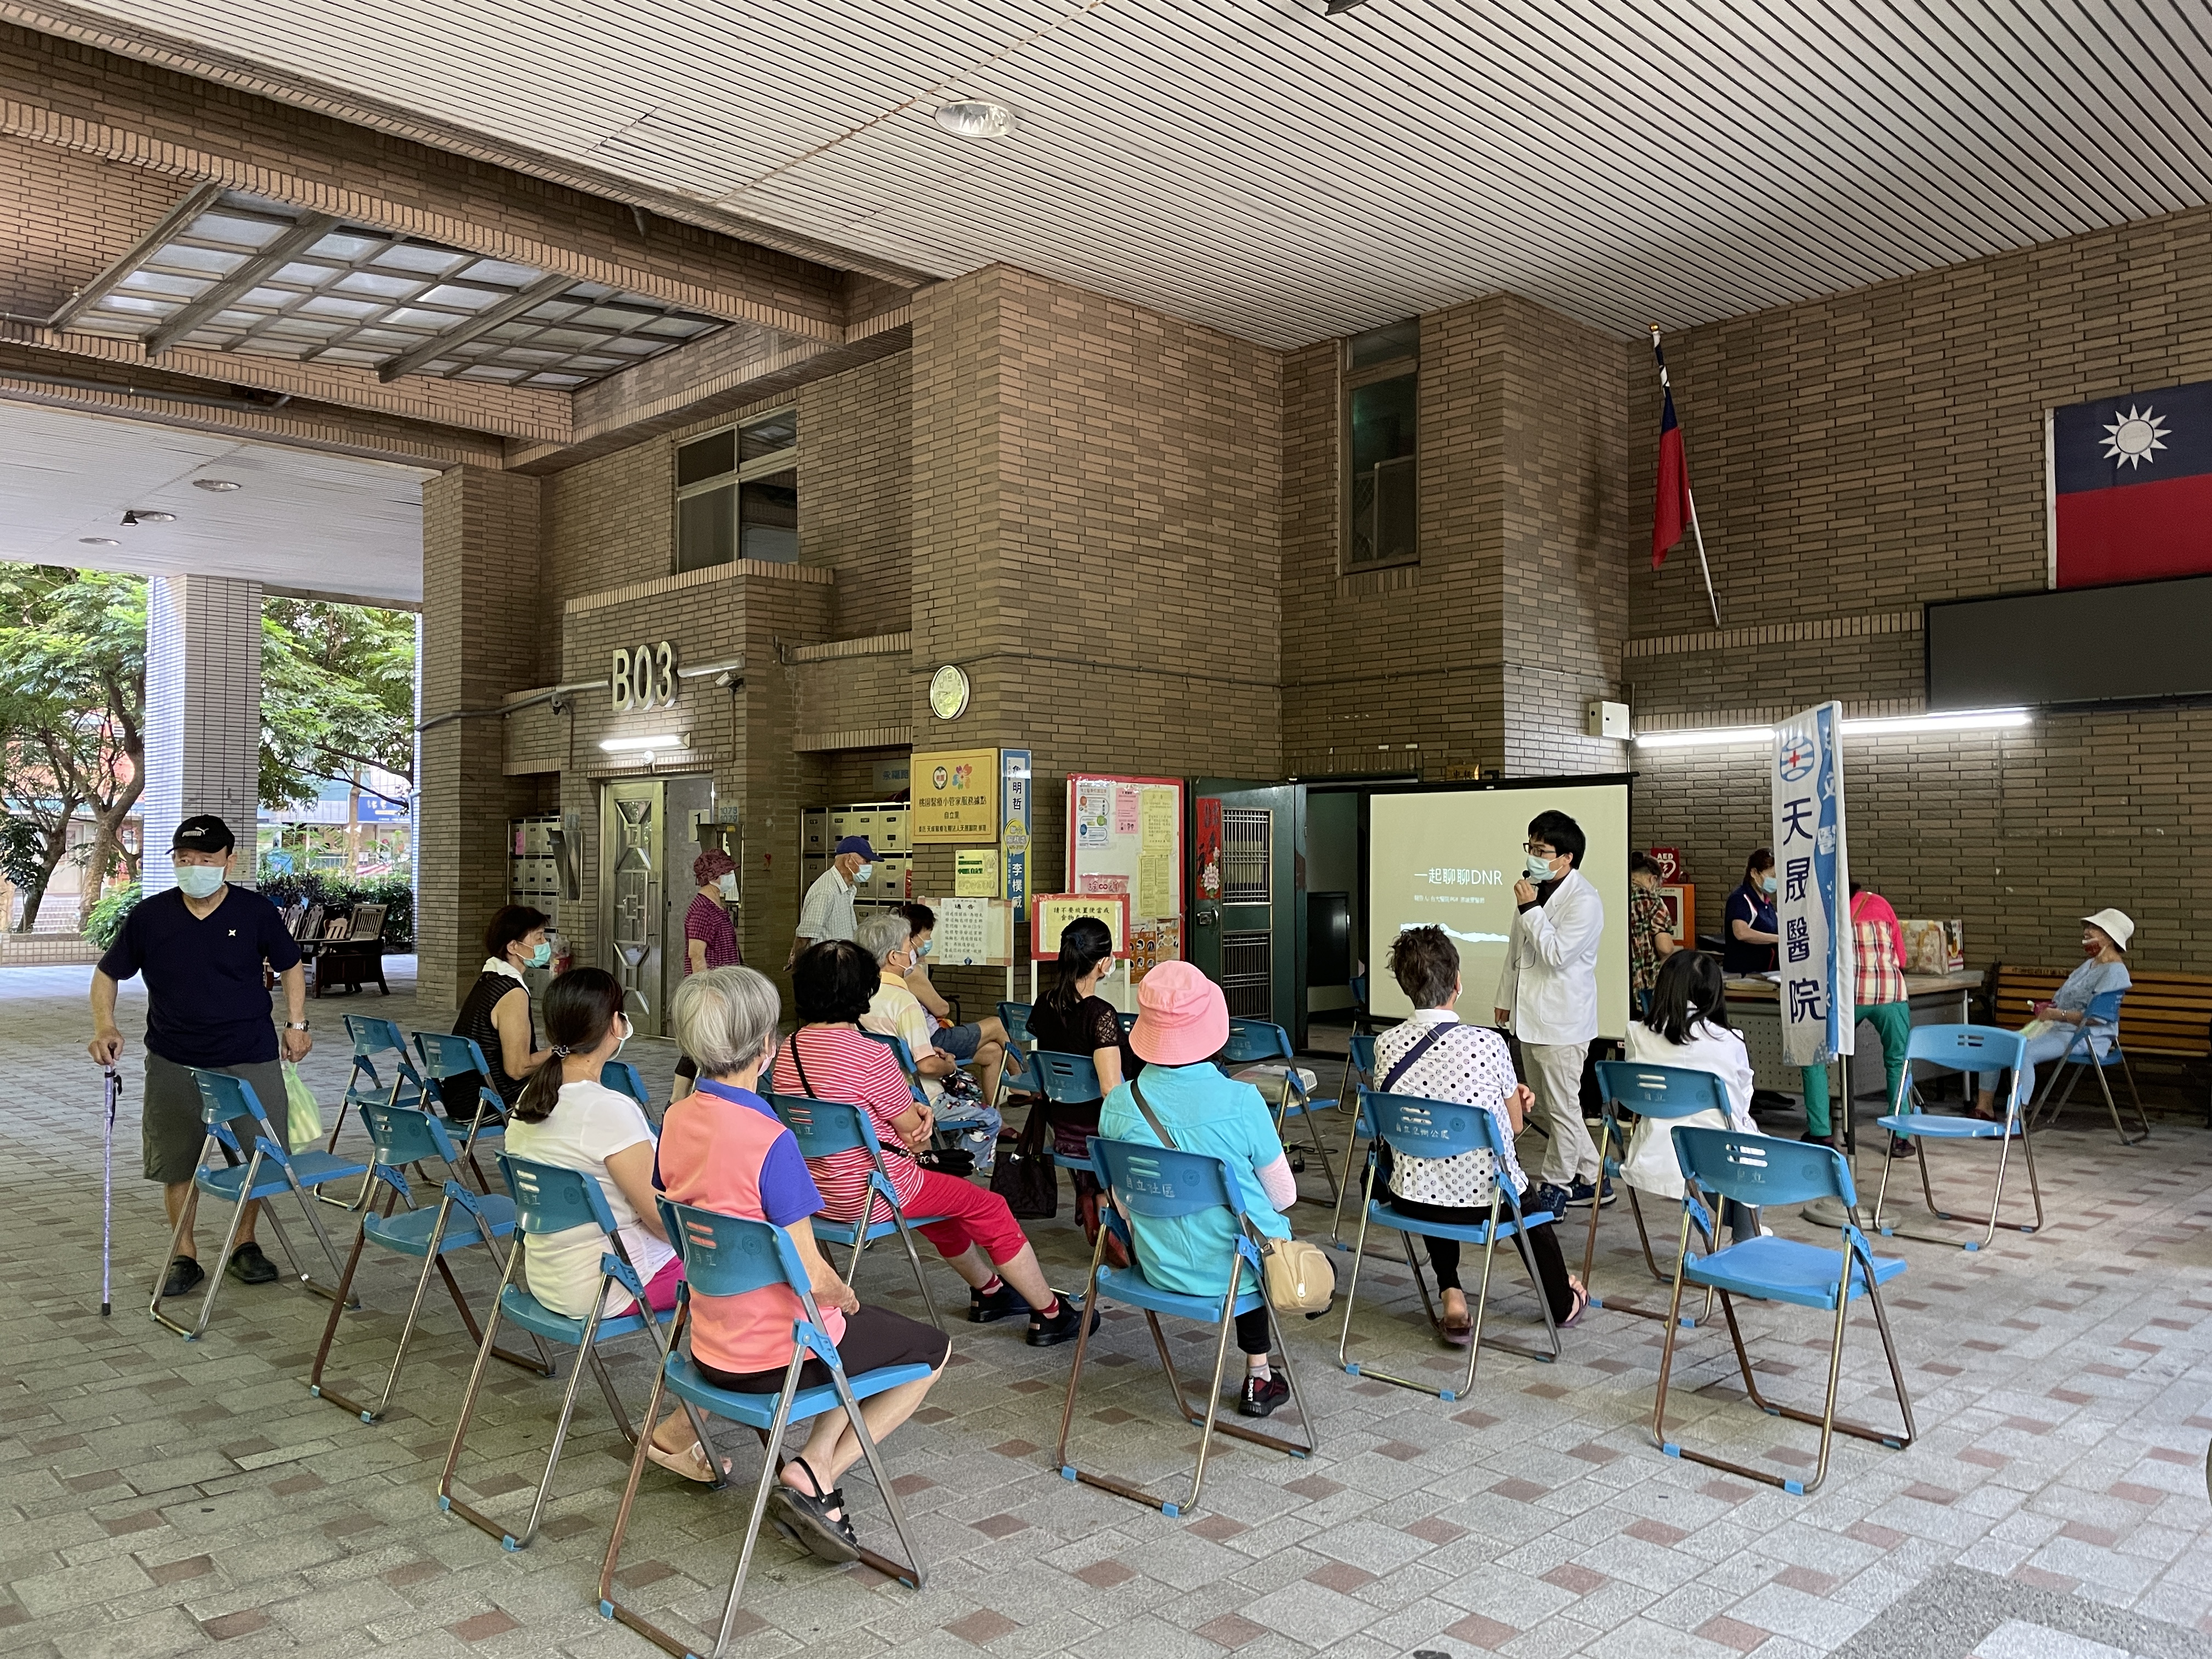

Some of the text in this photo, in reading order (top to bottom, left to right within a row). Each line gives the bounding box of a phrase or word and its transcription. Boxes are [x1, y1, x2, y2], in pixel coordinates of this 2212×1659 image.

[944, 811, 960, 820] 自立里
[1414, 867, 1503, 885] 一起聊聊DNR
[1053, 906, 1110, 915] 請不要放置便當或
[1782, 797, 1826, 1025] 天晟醫院
[1125, 1173, 1176, 1198] 自立社區
